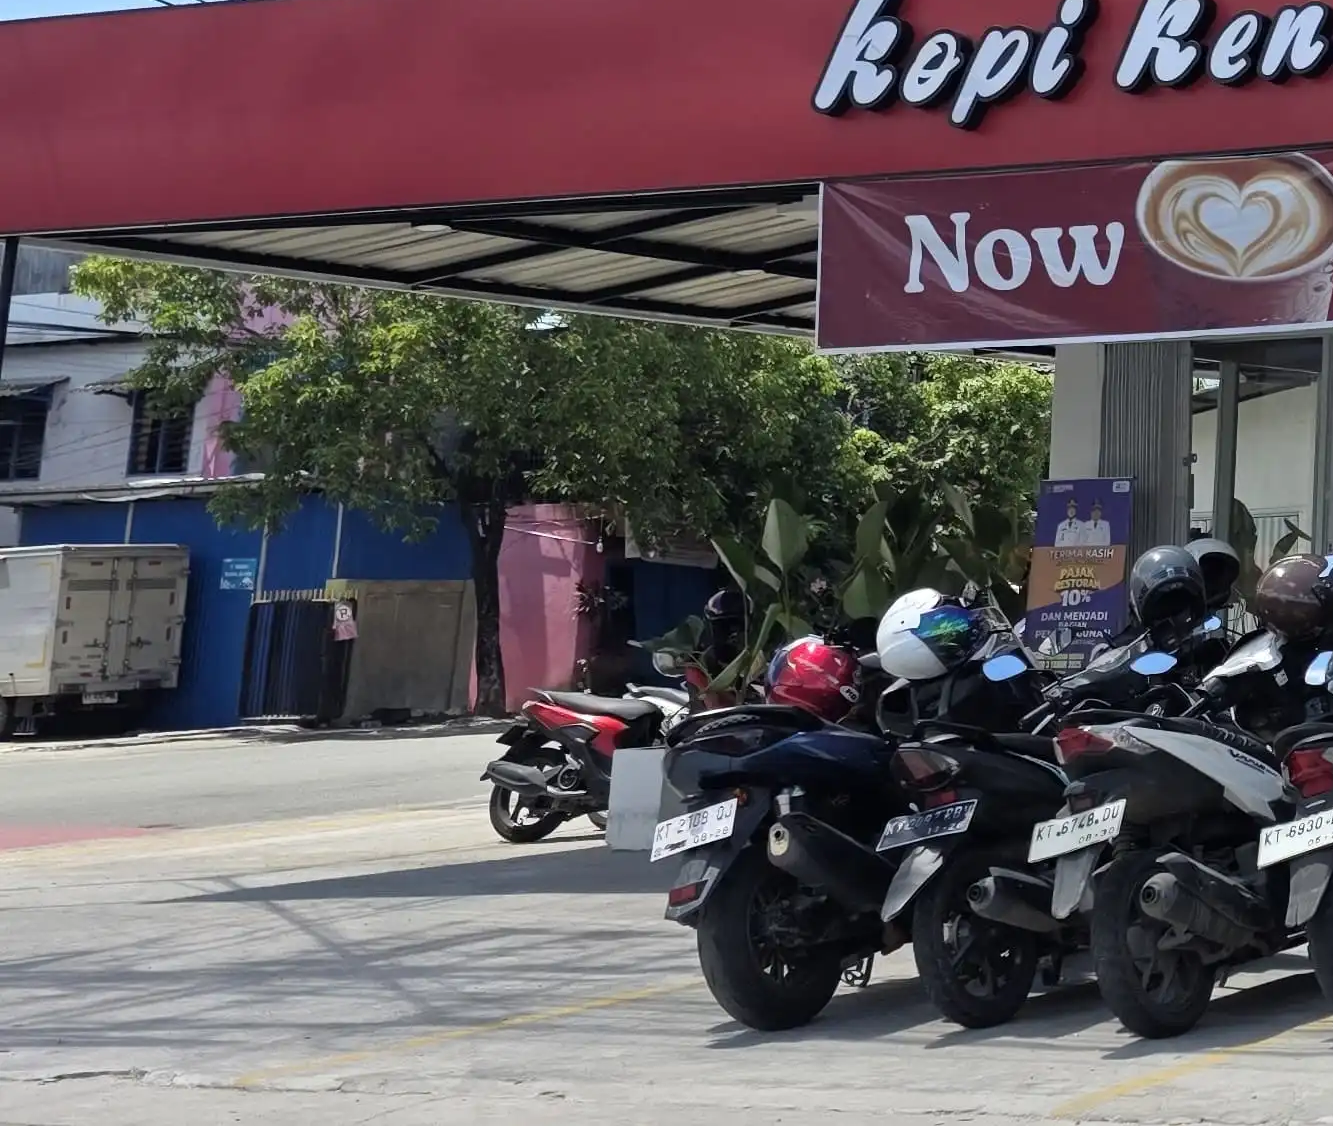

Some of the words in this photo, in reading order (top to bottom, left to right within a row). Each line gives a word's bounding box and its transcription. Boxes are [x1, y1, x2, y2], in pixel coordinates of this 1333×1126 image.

[903, 211, 1125, 294] Now
[1086, 548, 1115, 559] KASIH
[1060, 567, 1095, 580] PAJAK
[1061, 589, 1091, 607] 10%
[1041, 612, 1062, 622] DAN
[1063, 611, 1108, 622] MENJADI
[657, 822, 672, 842] KT
[1036, 824, 1055, 842] KT
[1264, 829, 1283, 847] KT
[1289, 816, 1323, 838] 6930
